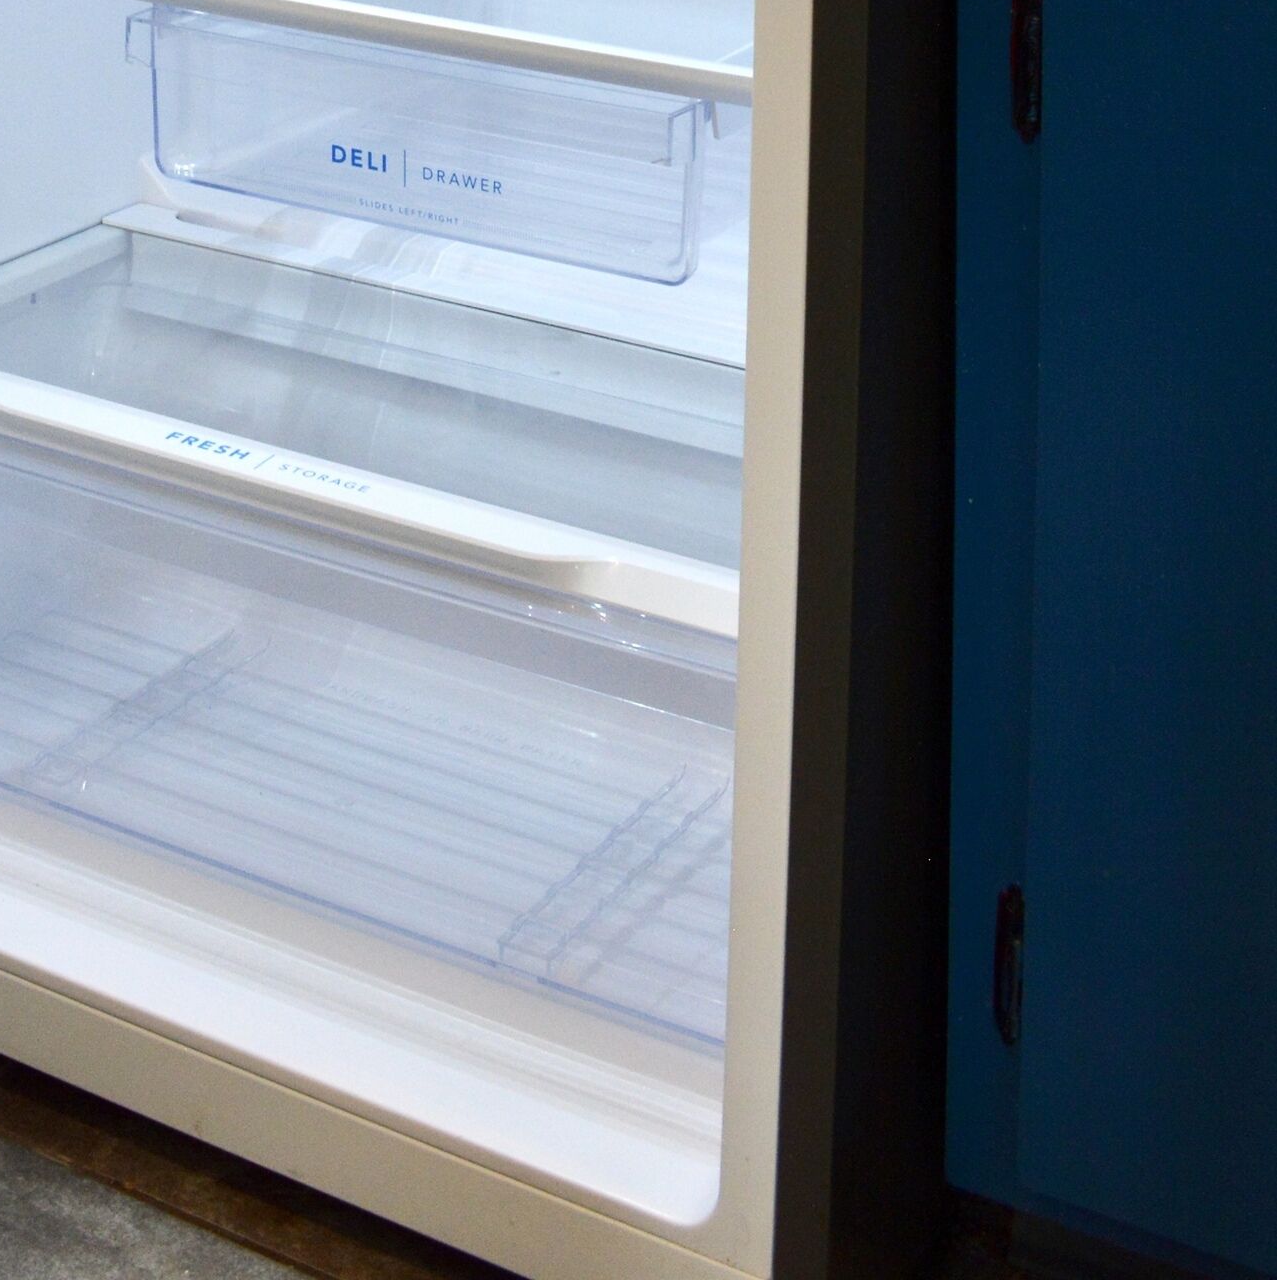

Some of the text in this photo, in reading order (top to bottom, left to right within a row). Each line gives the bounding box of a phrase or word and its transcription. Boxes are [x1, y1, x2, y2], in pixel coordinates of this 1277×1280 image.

[331, 144, 502, 195] DELI DRAWER
[358, 198, 459, 225] SLIDES LEFT/RIGHT
[165, 431, 372, 493] FRESH STORAGE
